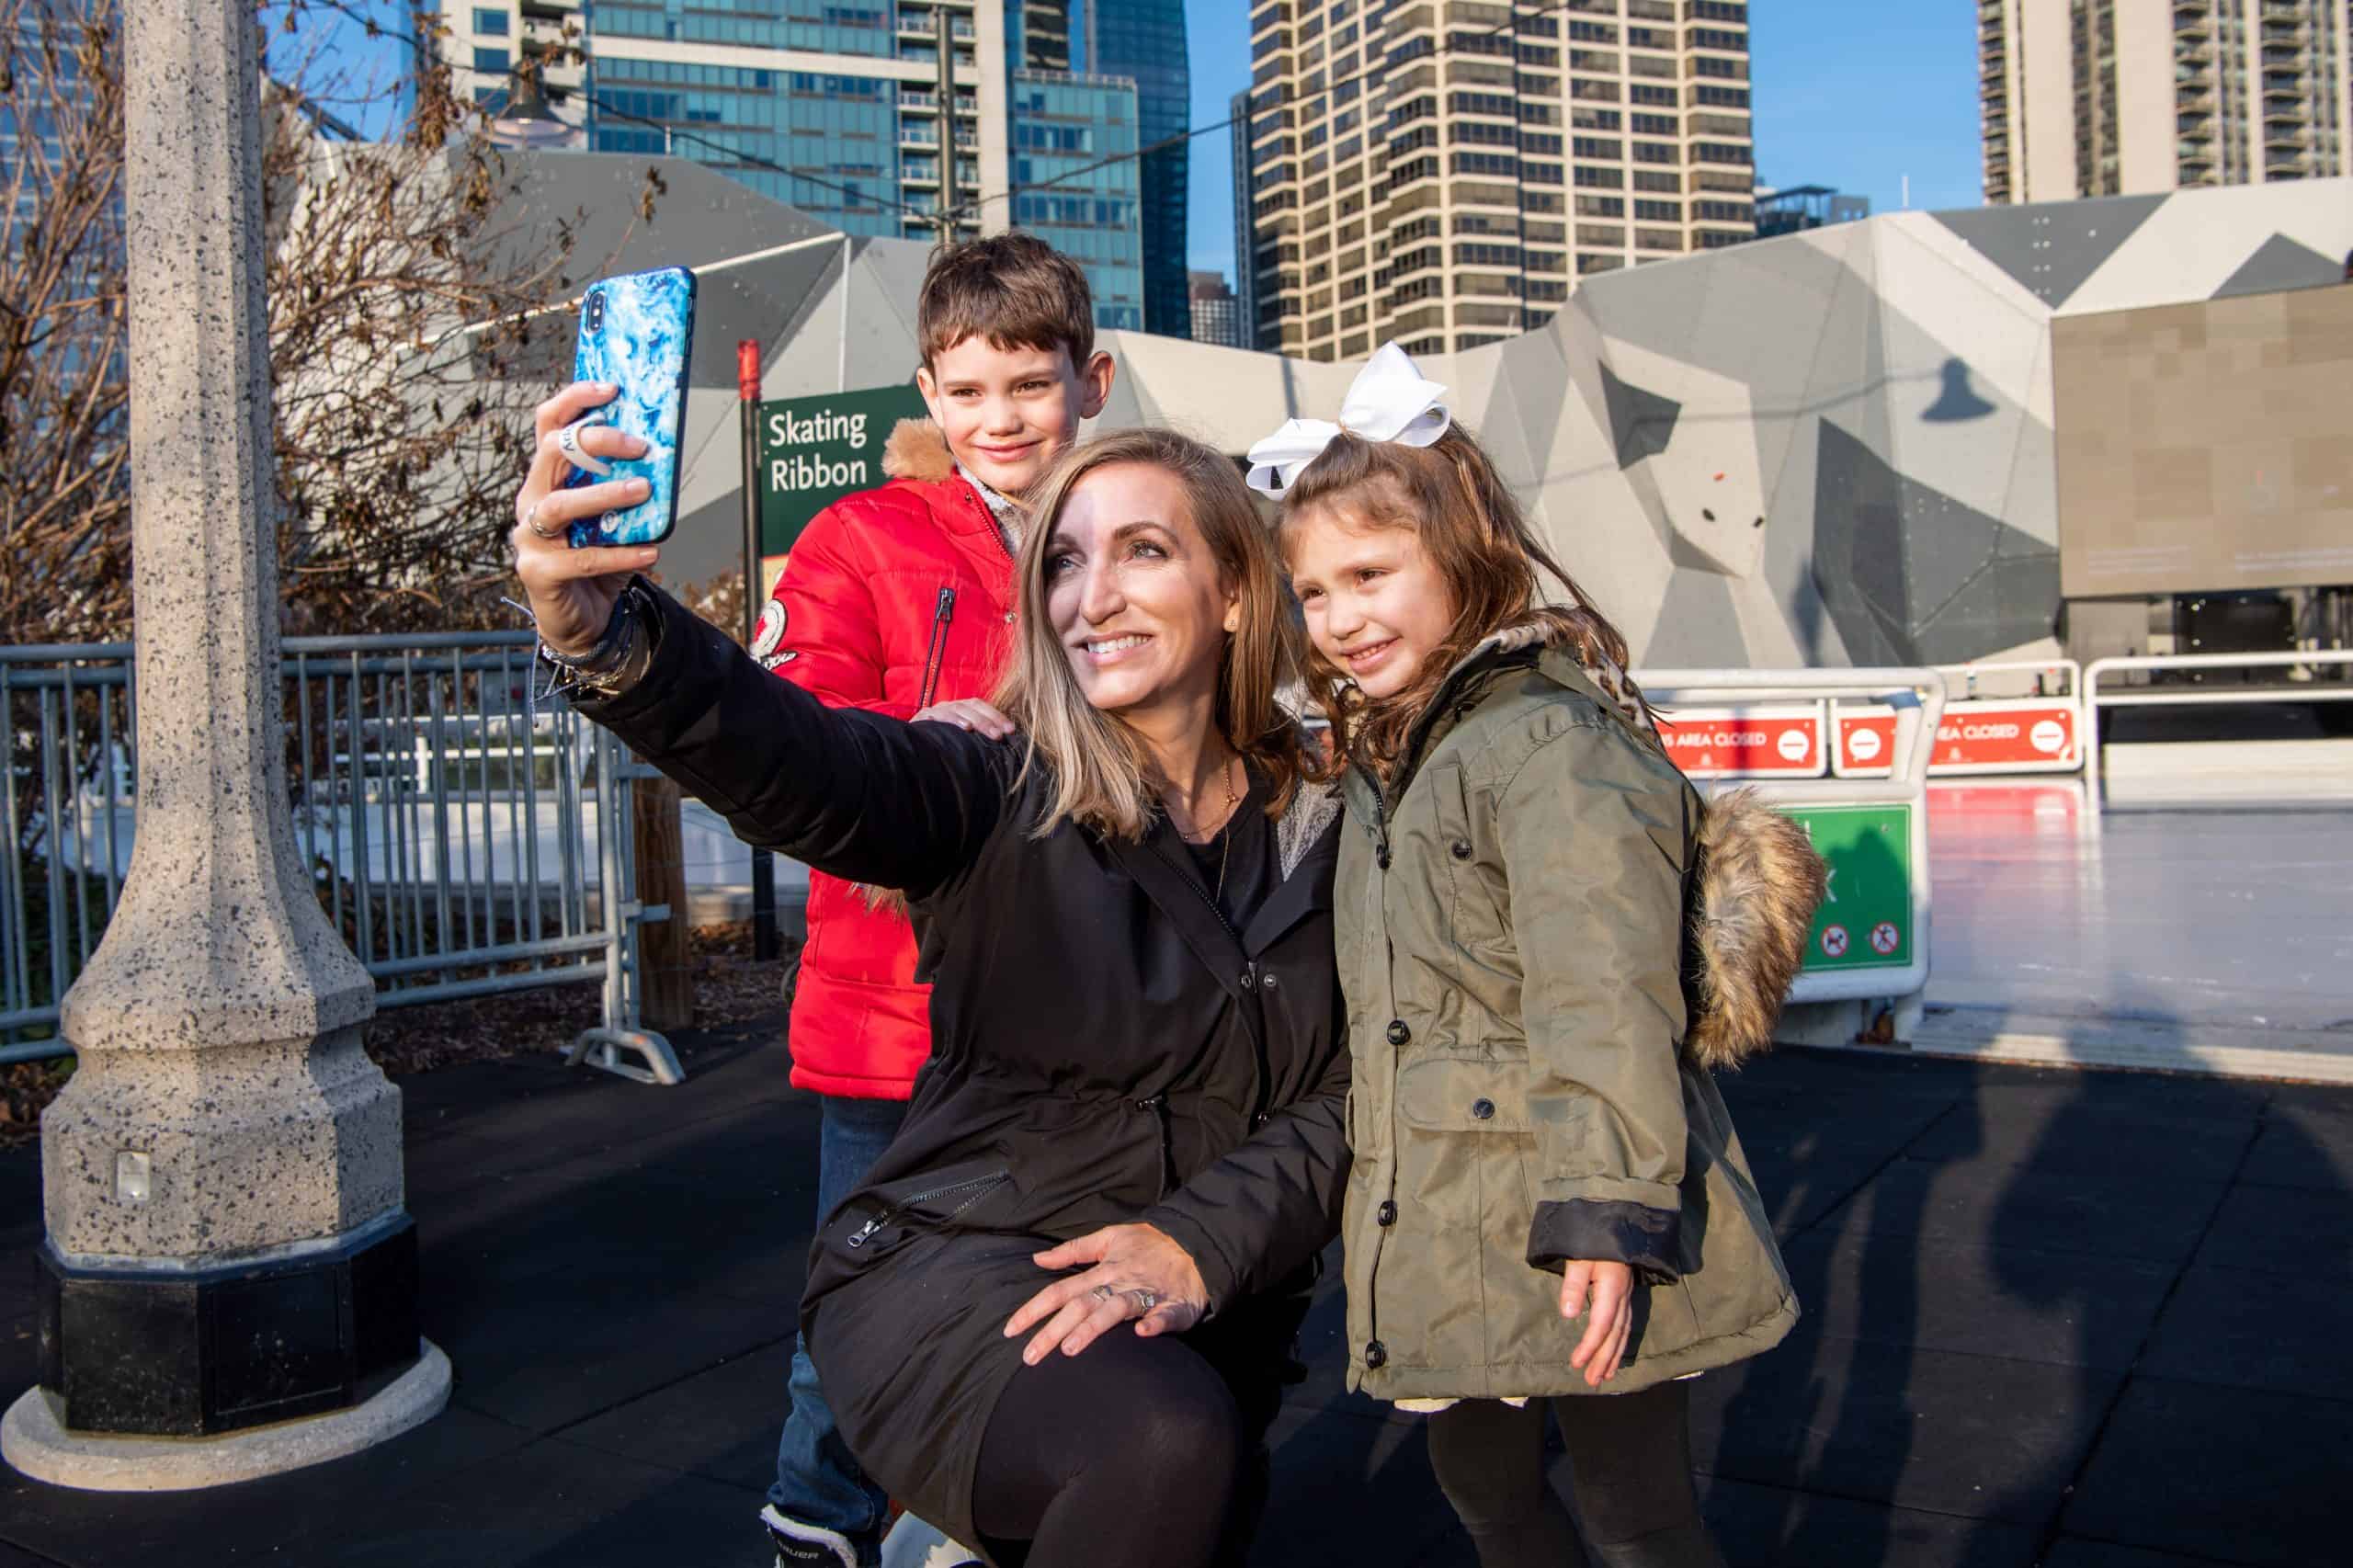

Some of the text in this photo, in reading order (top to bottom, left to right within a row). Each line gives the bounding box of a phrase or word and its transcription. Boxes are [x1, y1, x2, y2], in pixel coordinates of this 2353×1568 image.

[769, 409, 867, 449] Skating
[771, 453, 867, 492] Ribbon
[1677, 733, 1711, 747] AREA
[1714, 732, 1768, 746] CLOSED
[1963, 723, 2020, 740] CLOSED
